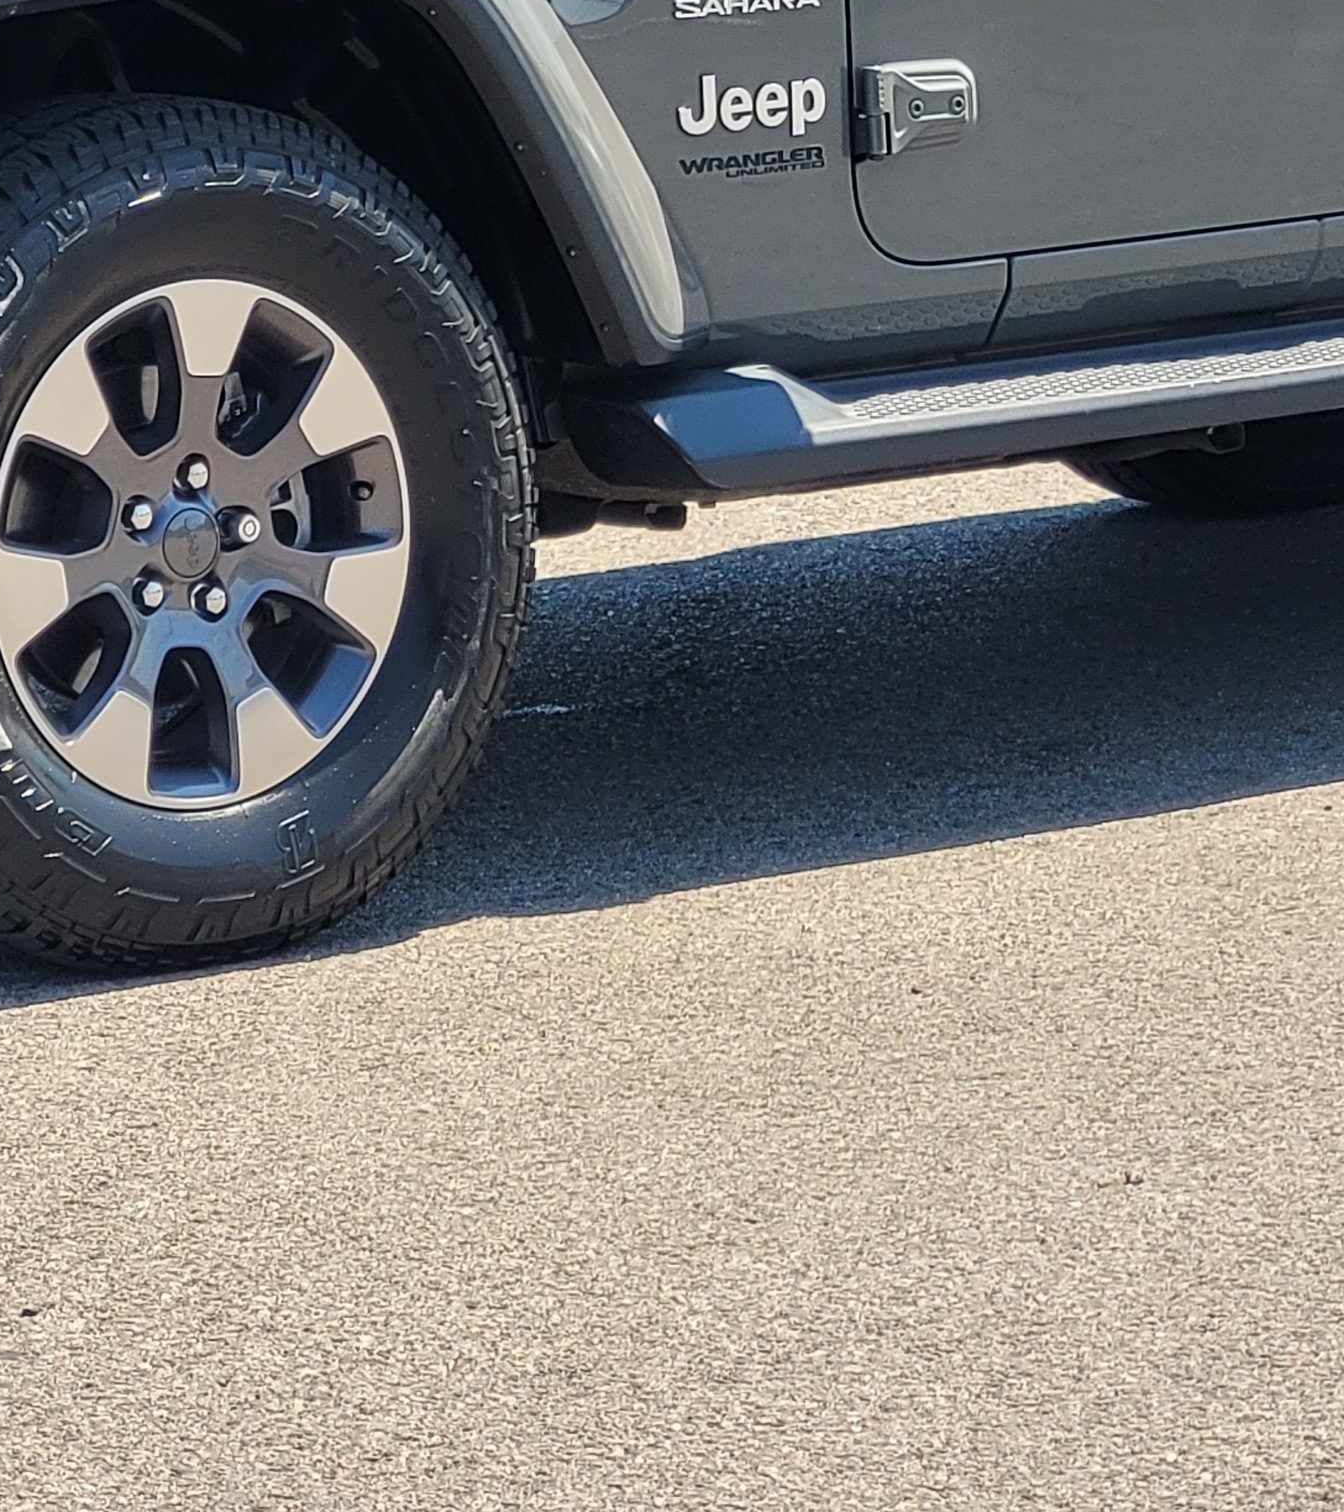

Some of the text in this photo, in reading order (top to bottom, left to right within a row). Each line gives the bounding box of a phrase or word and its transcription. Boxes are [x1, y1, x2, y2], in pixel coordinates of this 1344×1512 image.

[677, 74, 827, 137] Jeep
[678, 146, 825, 176] WRANGLER
[725, 159, 825, 179] UNLIMITED
